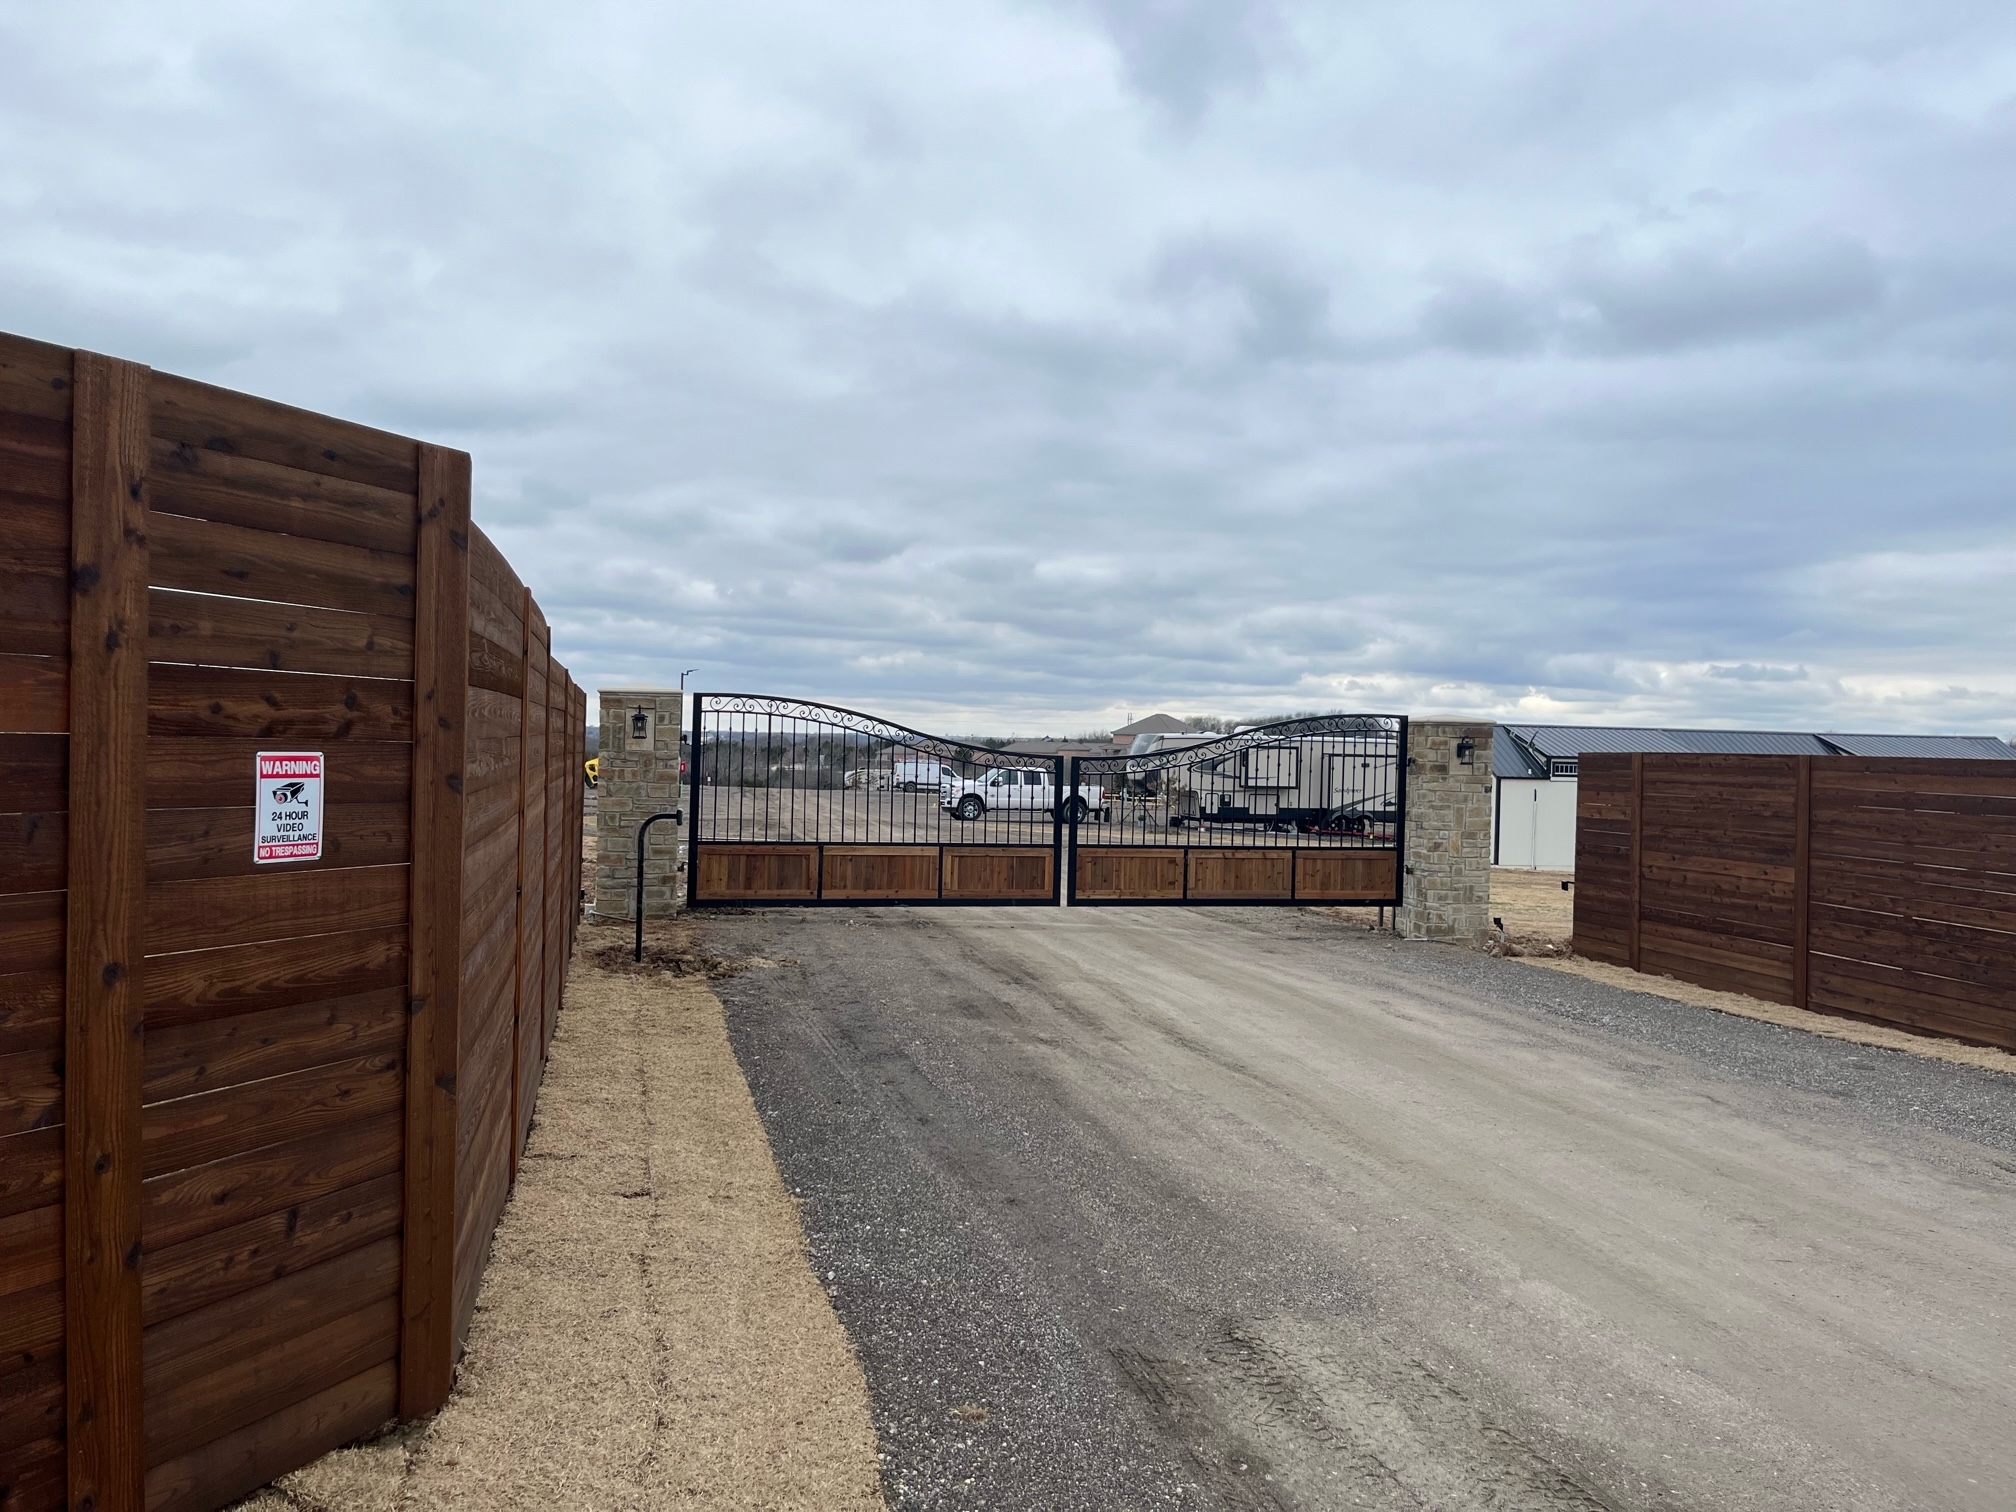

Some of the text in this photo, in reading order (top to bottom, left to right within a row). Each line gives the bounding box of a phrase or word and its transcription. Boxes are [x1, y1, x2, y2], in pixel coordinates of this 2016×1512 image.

[261, 760, 320, 775] WARNING
[272, 811, 309, 821] 24 HOUR
[276, 823, 304, 832] VIDEO
[261, 833, 317, 844] SURVEILLANCE
[259, 844, 317, 857] NO TRESPASSING
